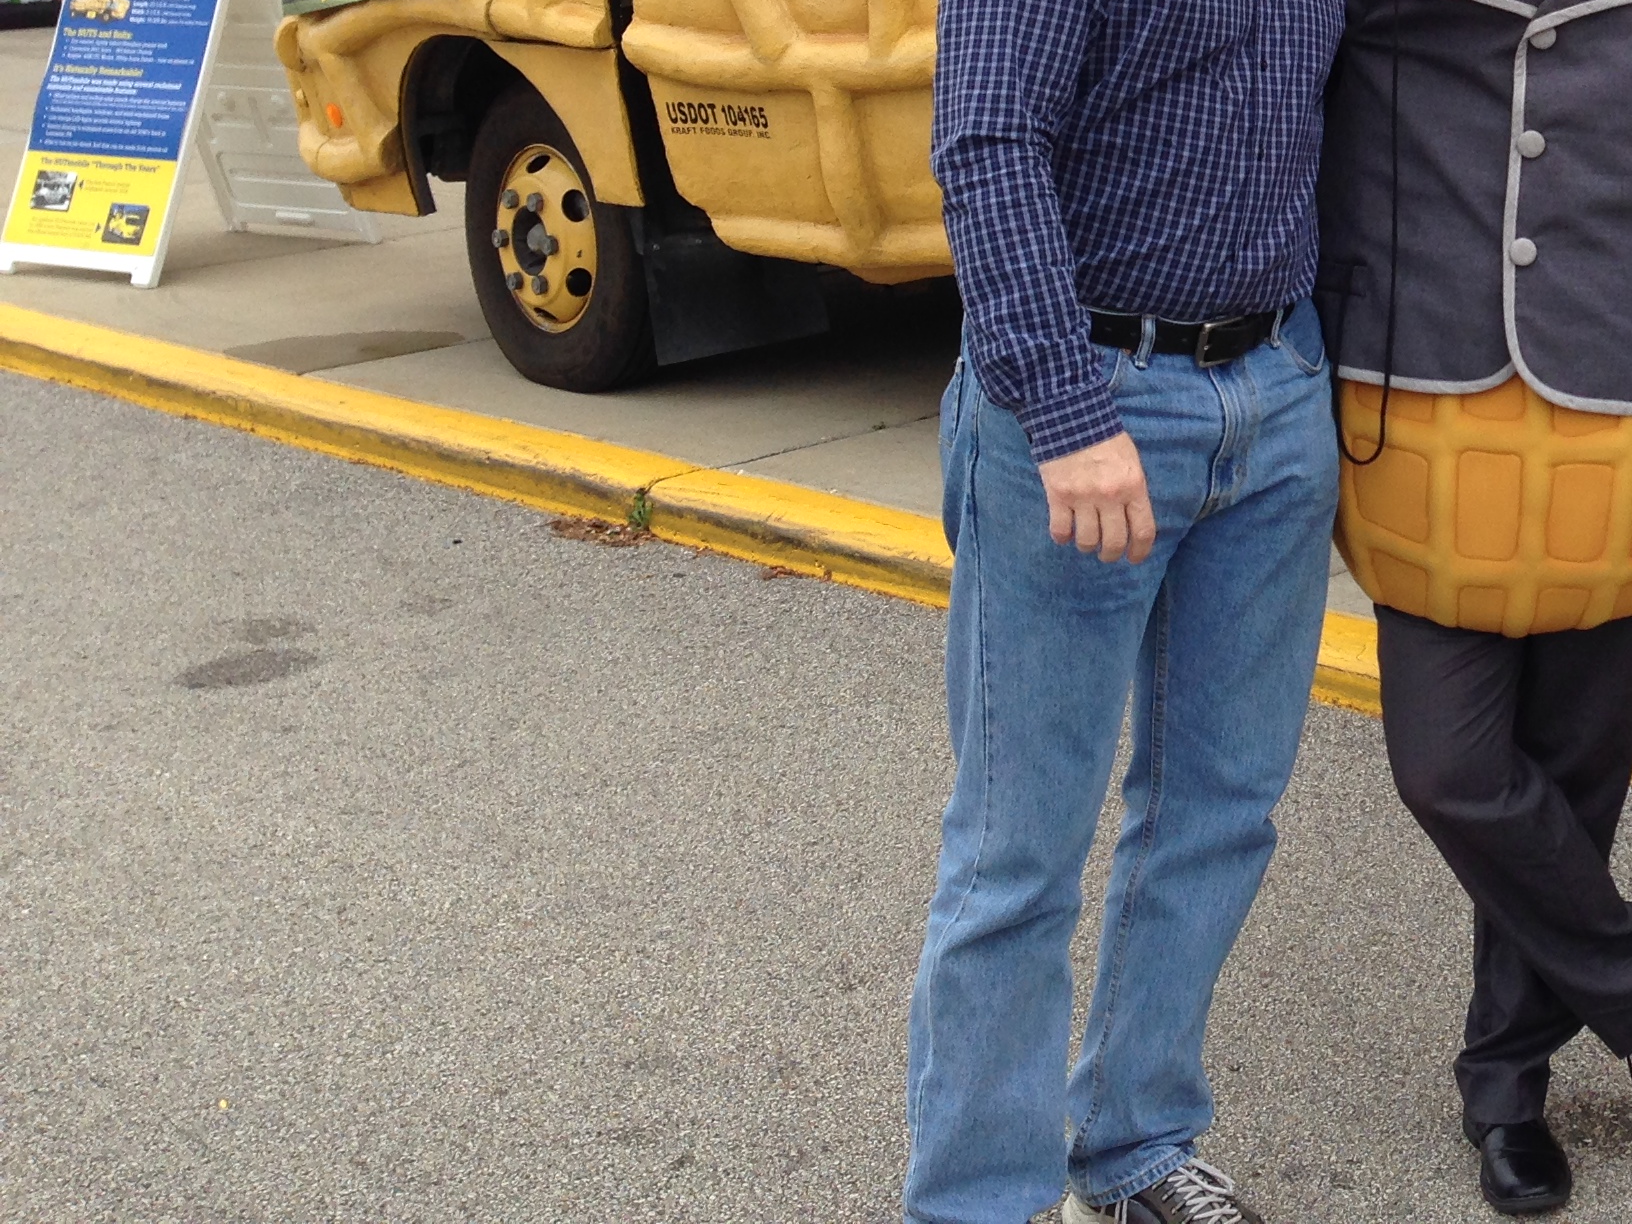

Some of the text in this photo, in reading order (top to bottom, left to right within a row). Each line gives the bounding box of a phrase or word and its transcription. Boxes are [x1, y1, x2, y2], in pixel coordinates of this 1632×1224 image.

[665, 101, 769, 130] USDOT 104165
[671, 126, 697, 135] KRAFT
[700, 127, 726, 137] FOODS
